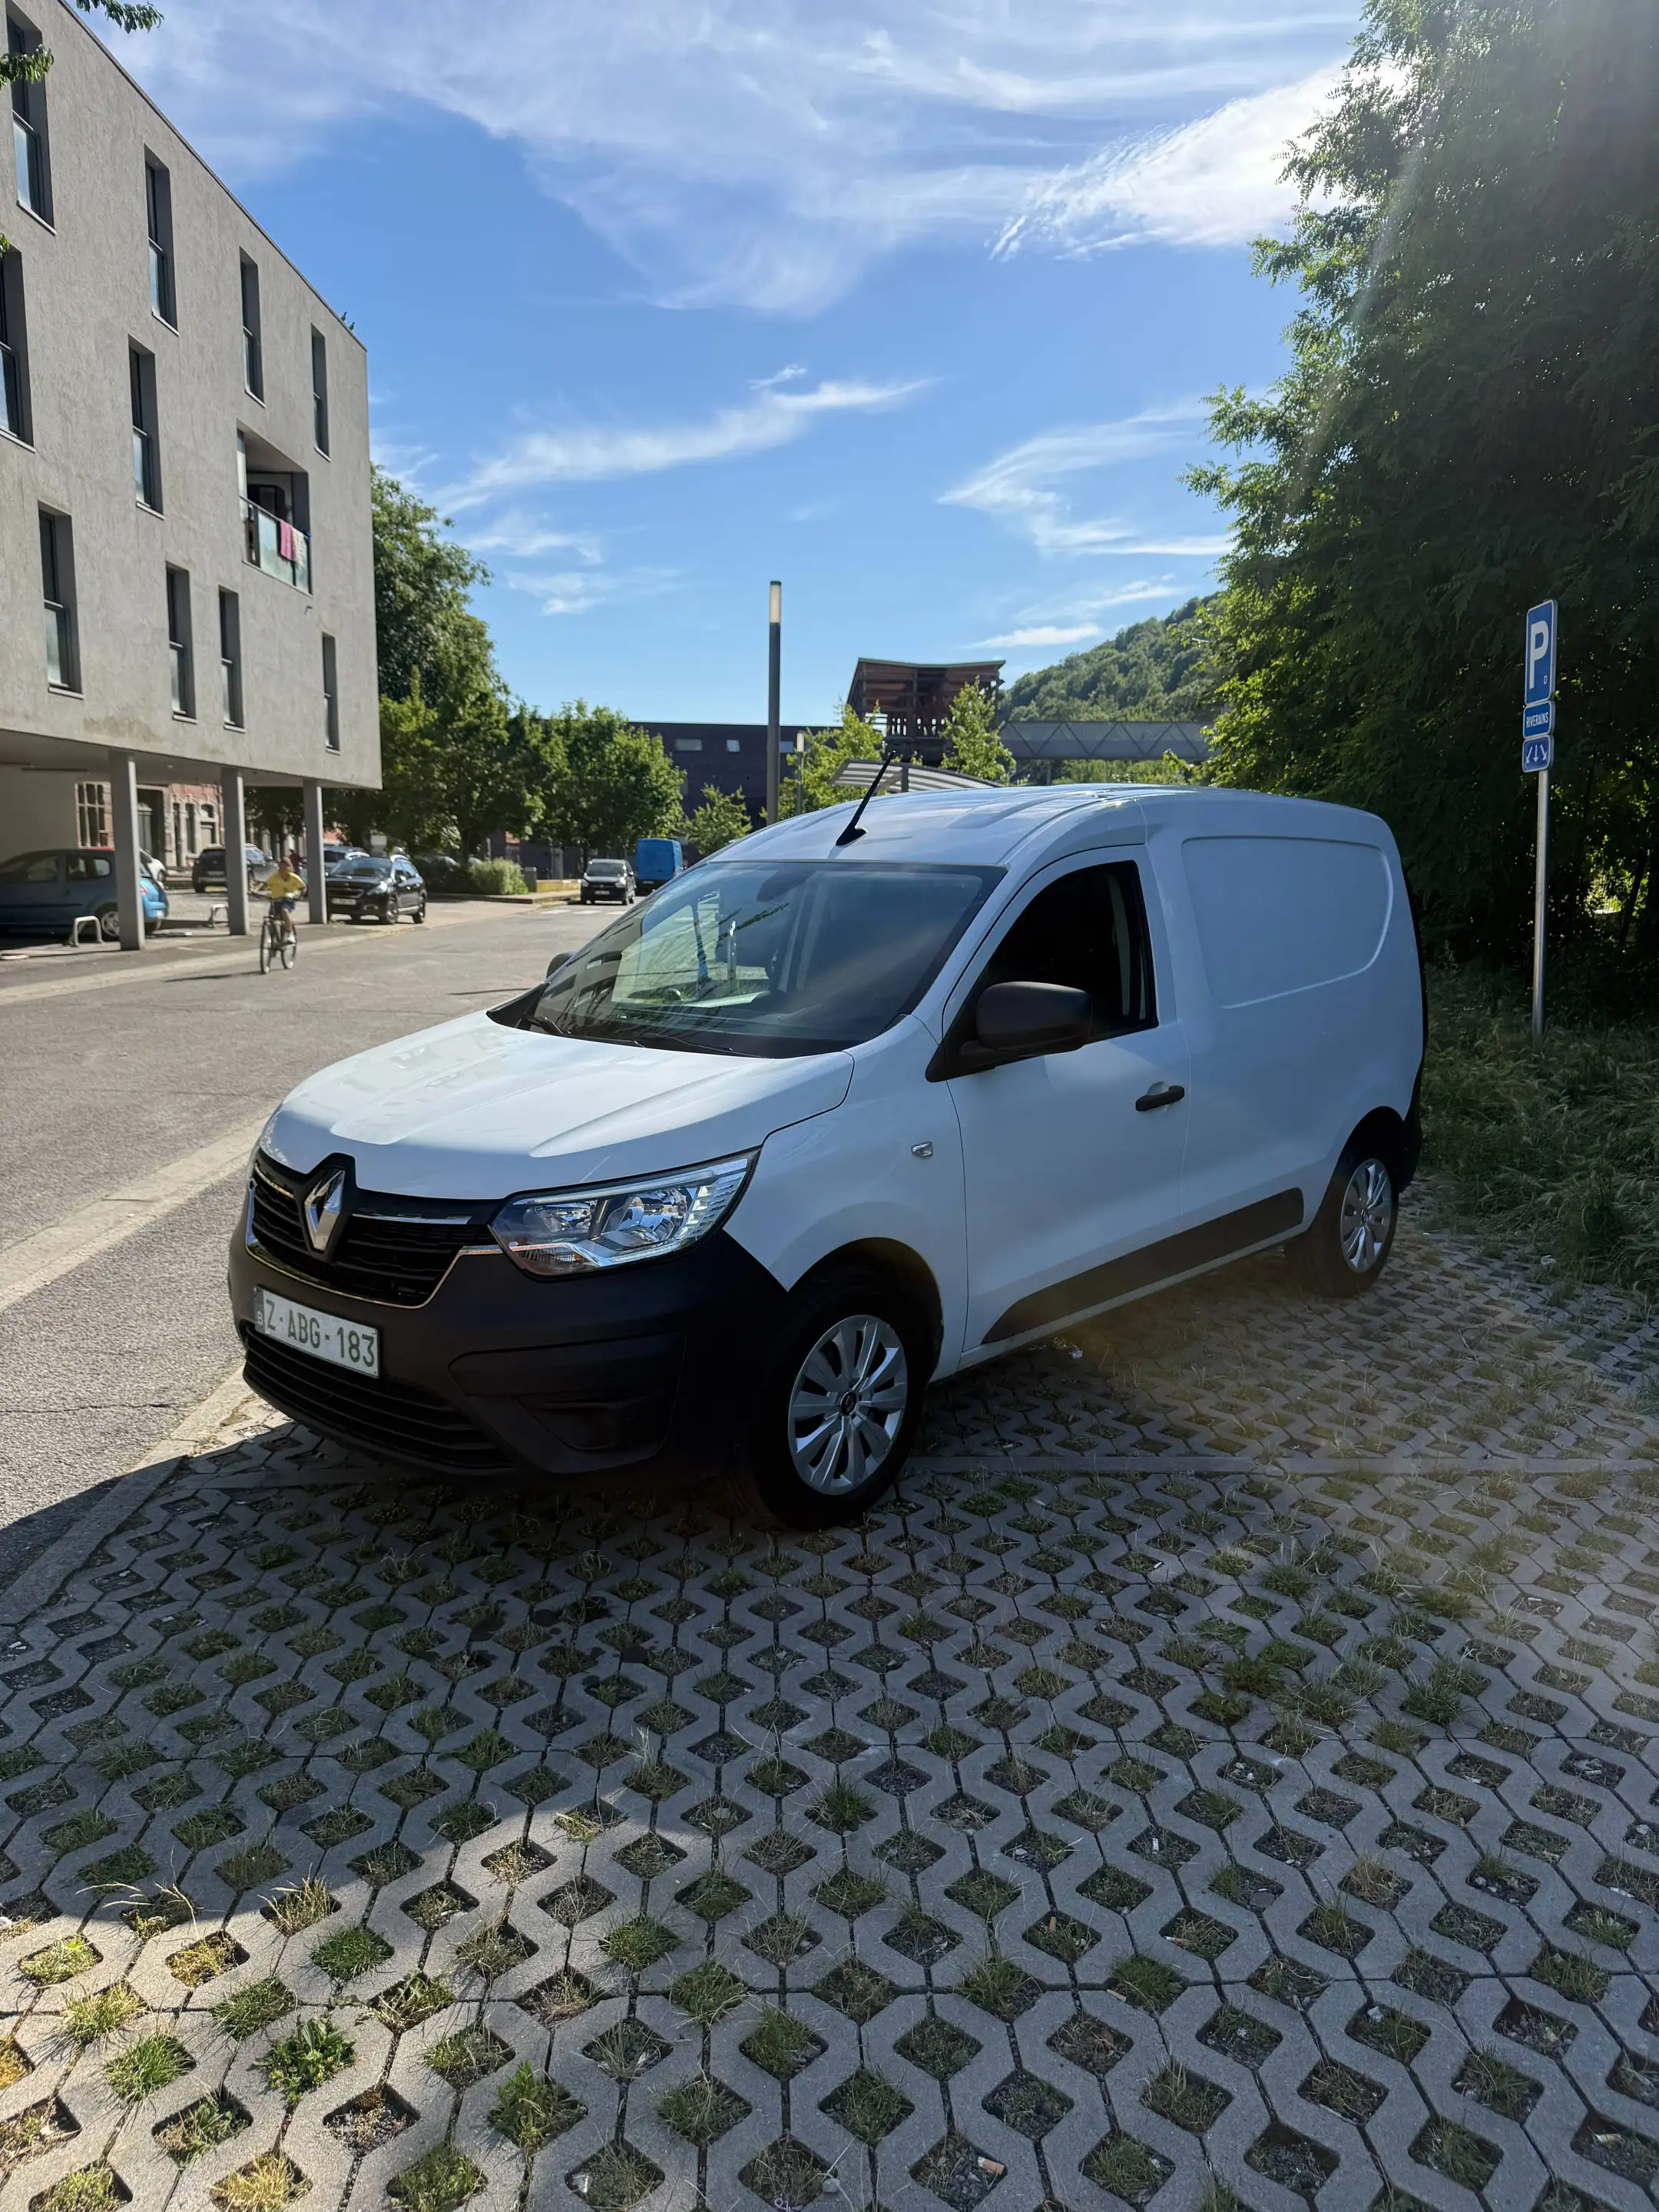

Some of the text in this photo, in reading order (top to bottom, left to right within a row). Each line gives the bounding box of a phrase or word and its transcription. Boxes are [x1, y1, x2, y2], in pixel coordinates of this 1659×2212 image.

[1529, 620, 1549, 690] P
[1526, 711, 1549, 728] RIVERAINS
[257, 1299, 376, 1367] B Z-ABG-183
